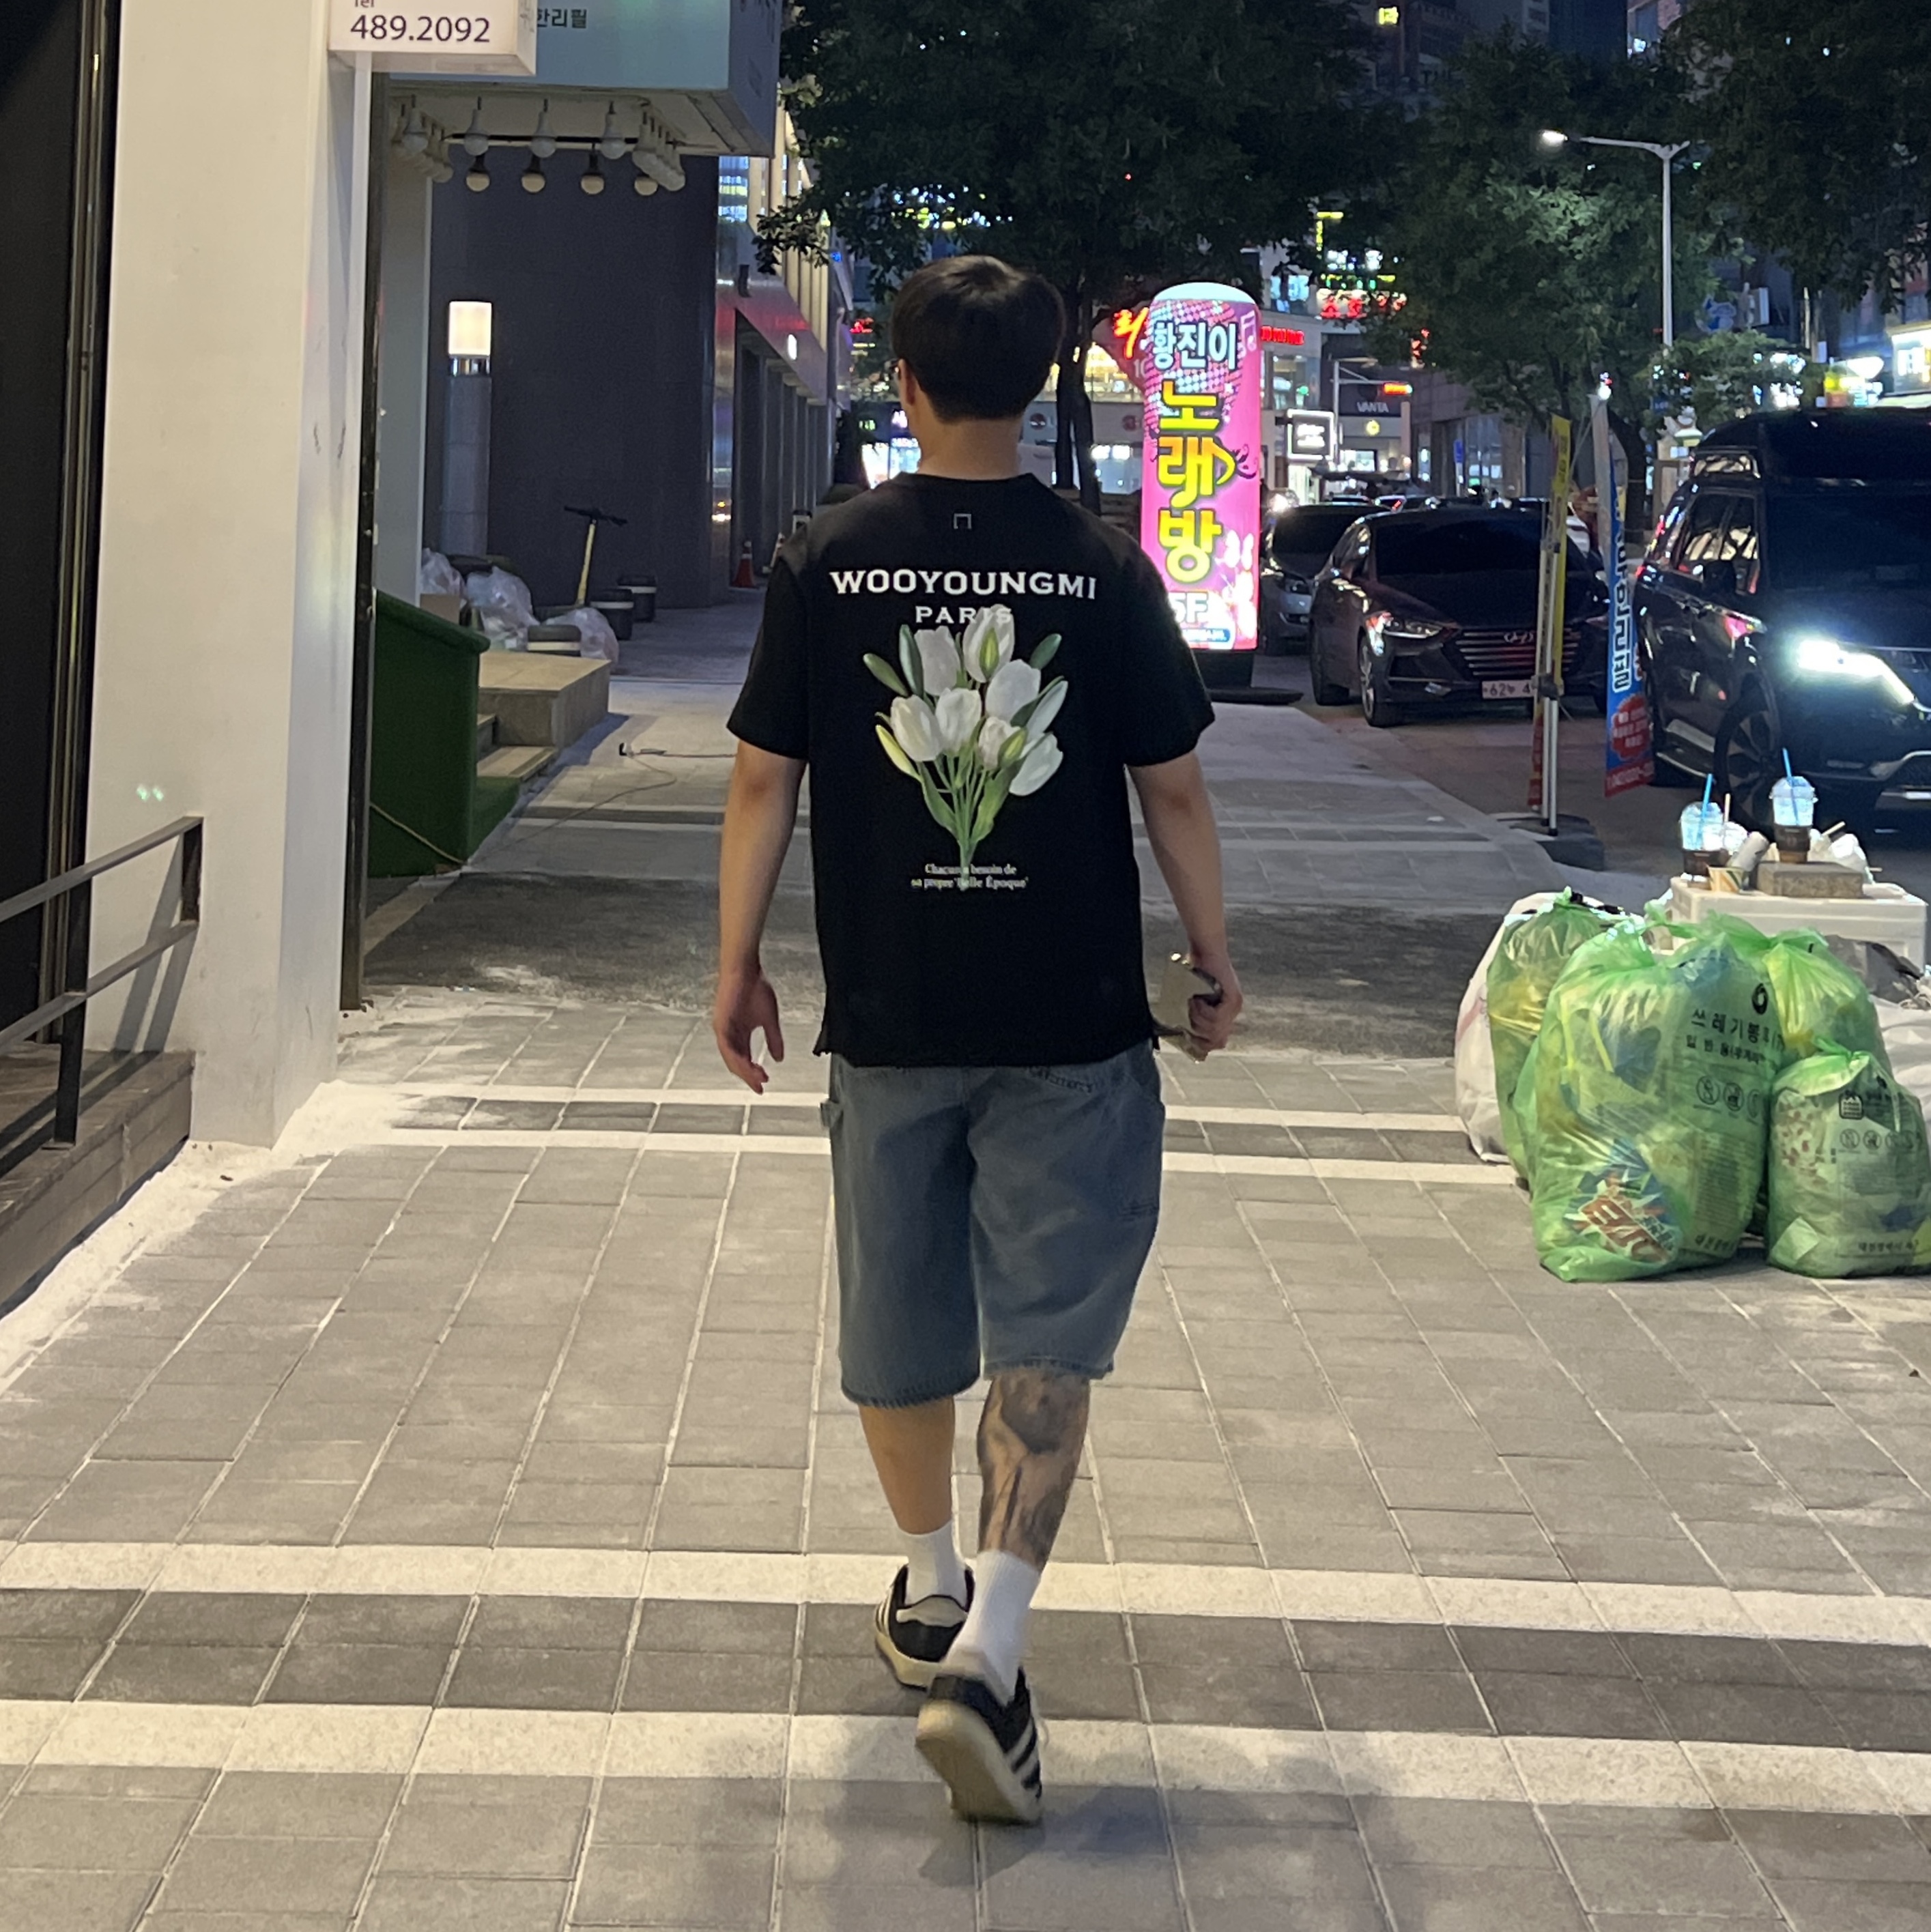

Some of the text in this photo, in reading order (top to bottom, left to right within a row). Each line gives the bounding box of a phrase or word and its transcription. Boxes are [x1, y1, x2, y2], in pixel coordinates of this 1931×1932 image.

[350, 15, 490, 42] 489.2092
[1153, 321, 1238, 370] 황진이
[1356, 401, 1390, 413] VANTA
[1158, 379, 1236, 583] 노래방
[829, 568, 1097, 599] WOOYOUNGMI
